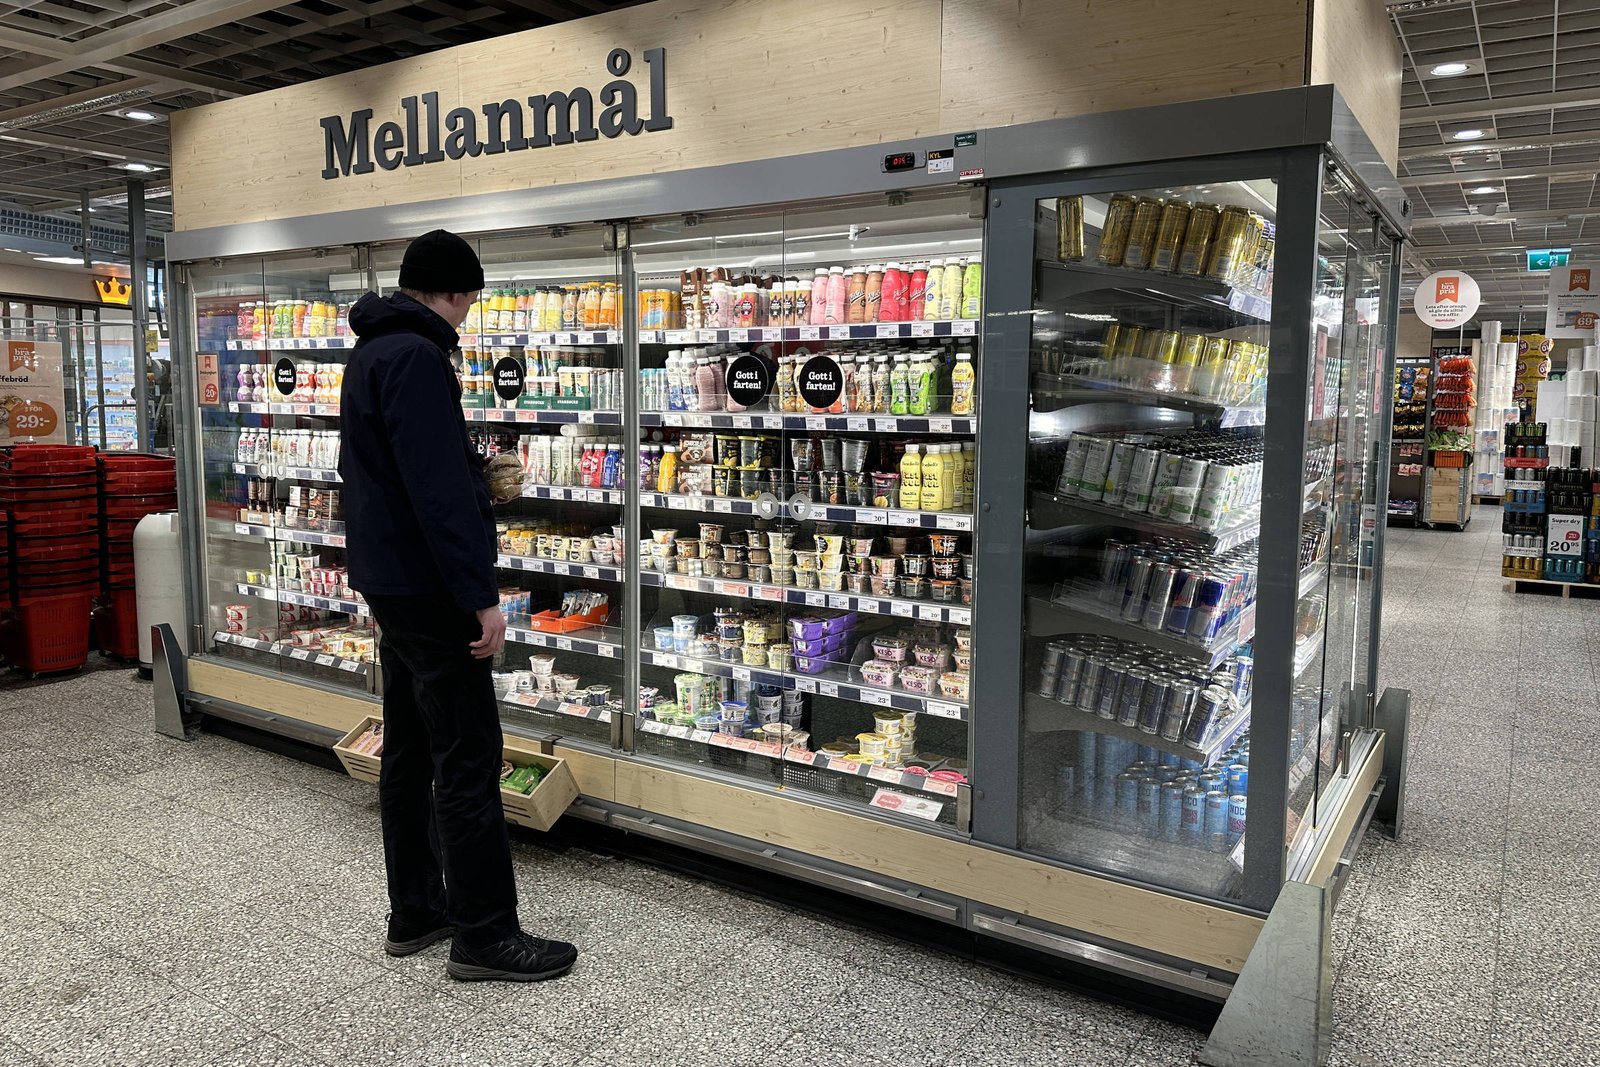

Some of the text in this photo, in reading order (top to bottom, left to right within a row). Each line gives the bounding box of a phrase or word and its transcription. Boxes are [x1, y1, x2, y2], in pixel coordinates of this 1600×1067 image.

[320, 47, 673, 179] Mellanmål
[735, 371, 753, 379] Gott
[808, 371, 828, 380] Gott
[498, 378, 520, 386] farten!
[733, 380, 761, 389] farten!
[806, 381, 836, 391] farten!
[1550, 540, 1570, 552] 20
[877, 648, 893, 657] KESO
[920, 654, 936, 663] KESO
[867, 673, 883, 682] KESO
[905, 680, 922, 689] KESO
[945, 686, 961, 695] KESO
